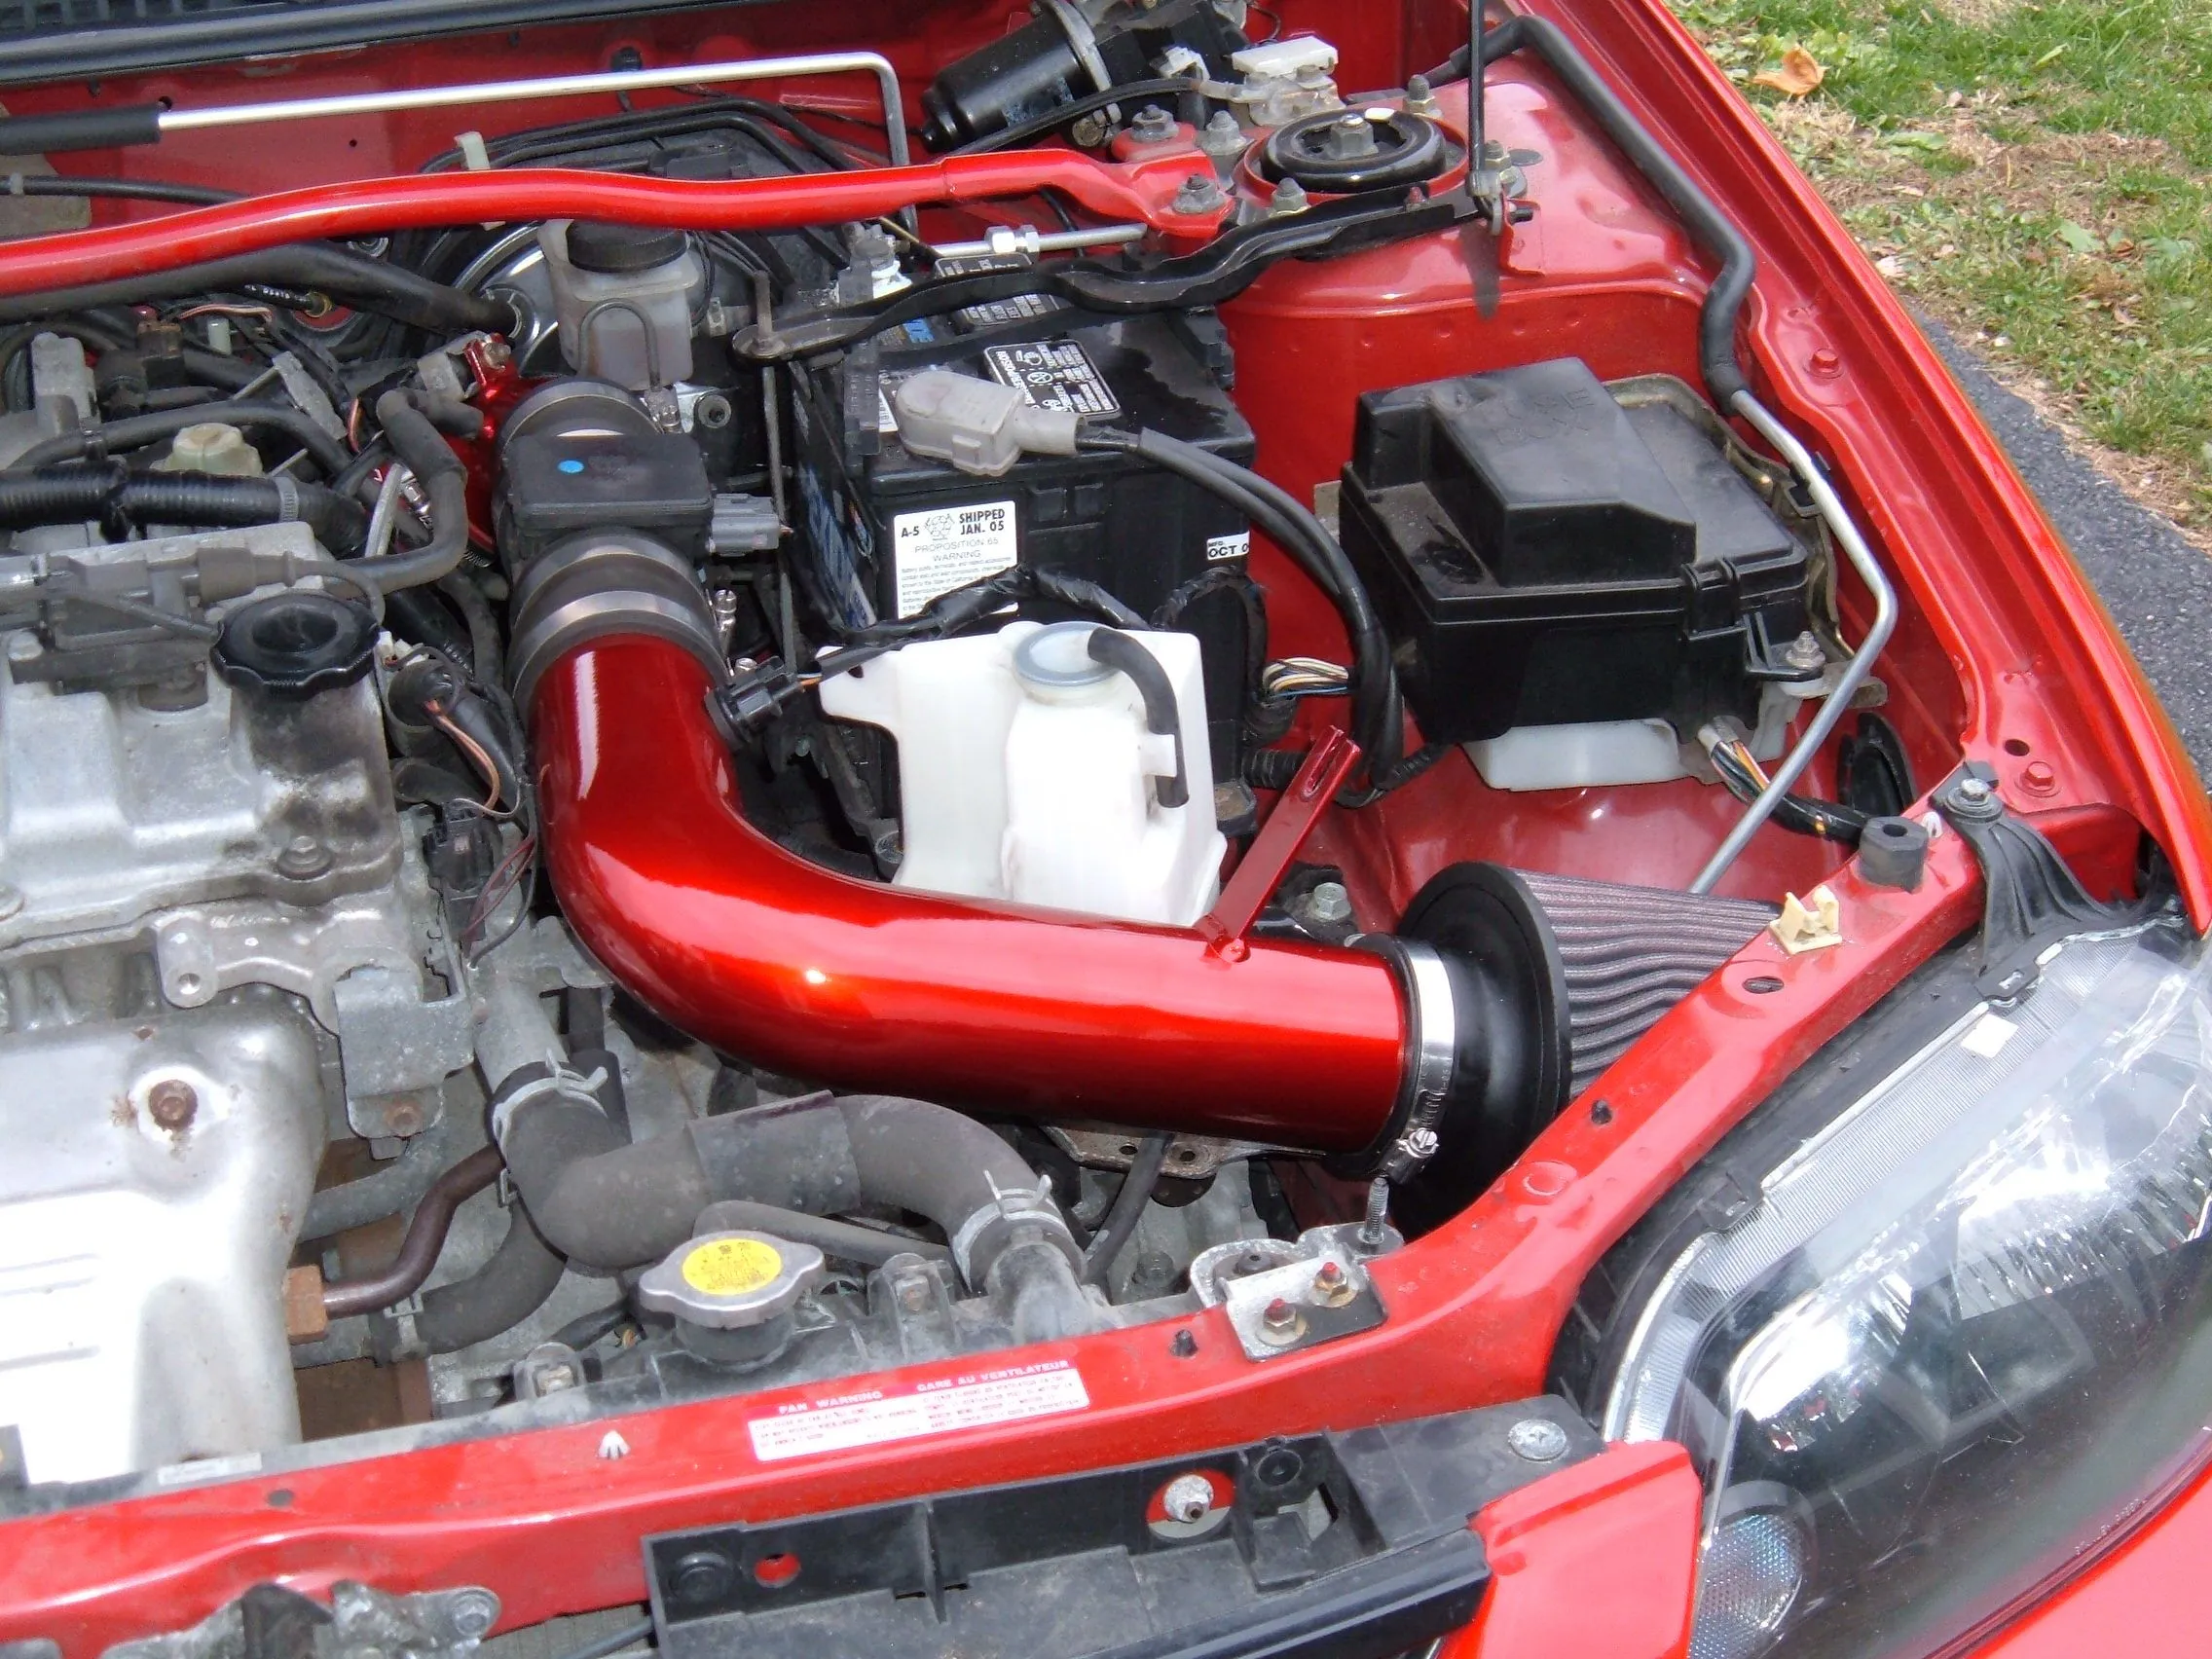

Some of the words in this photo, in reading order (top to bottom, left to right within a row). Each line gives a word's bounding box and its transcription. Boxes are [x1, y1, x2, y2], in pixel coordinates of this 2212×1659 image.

[959, 508, 1005, 524] SHIPPED
[901, 525, 920, 537] A-5
[960, 522, 985, 535] JAN.
[989, 520, 1005, 532] 05
[915, 538, 984, 554] PROPOSITION
[987, 536, 999, 545] 65
[1208, 544, 1237, 558] OCT
[933, 549, 981, 562] WARNING
[917, 1379, 952, 1392] GARE
[957, 1375, 977, 1385] AU
[980, 1360, 1069, 1382] VENTILATEUR
[816, 1390, 883, 1408] WARNING
